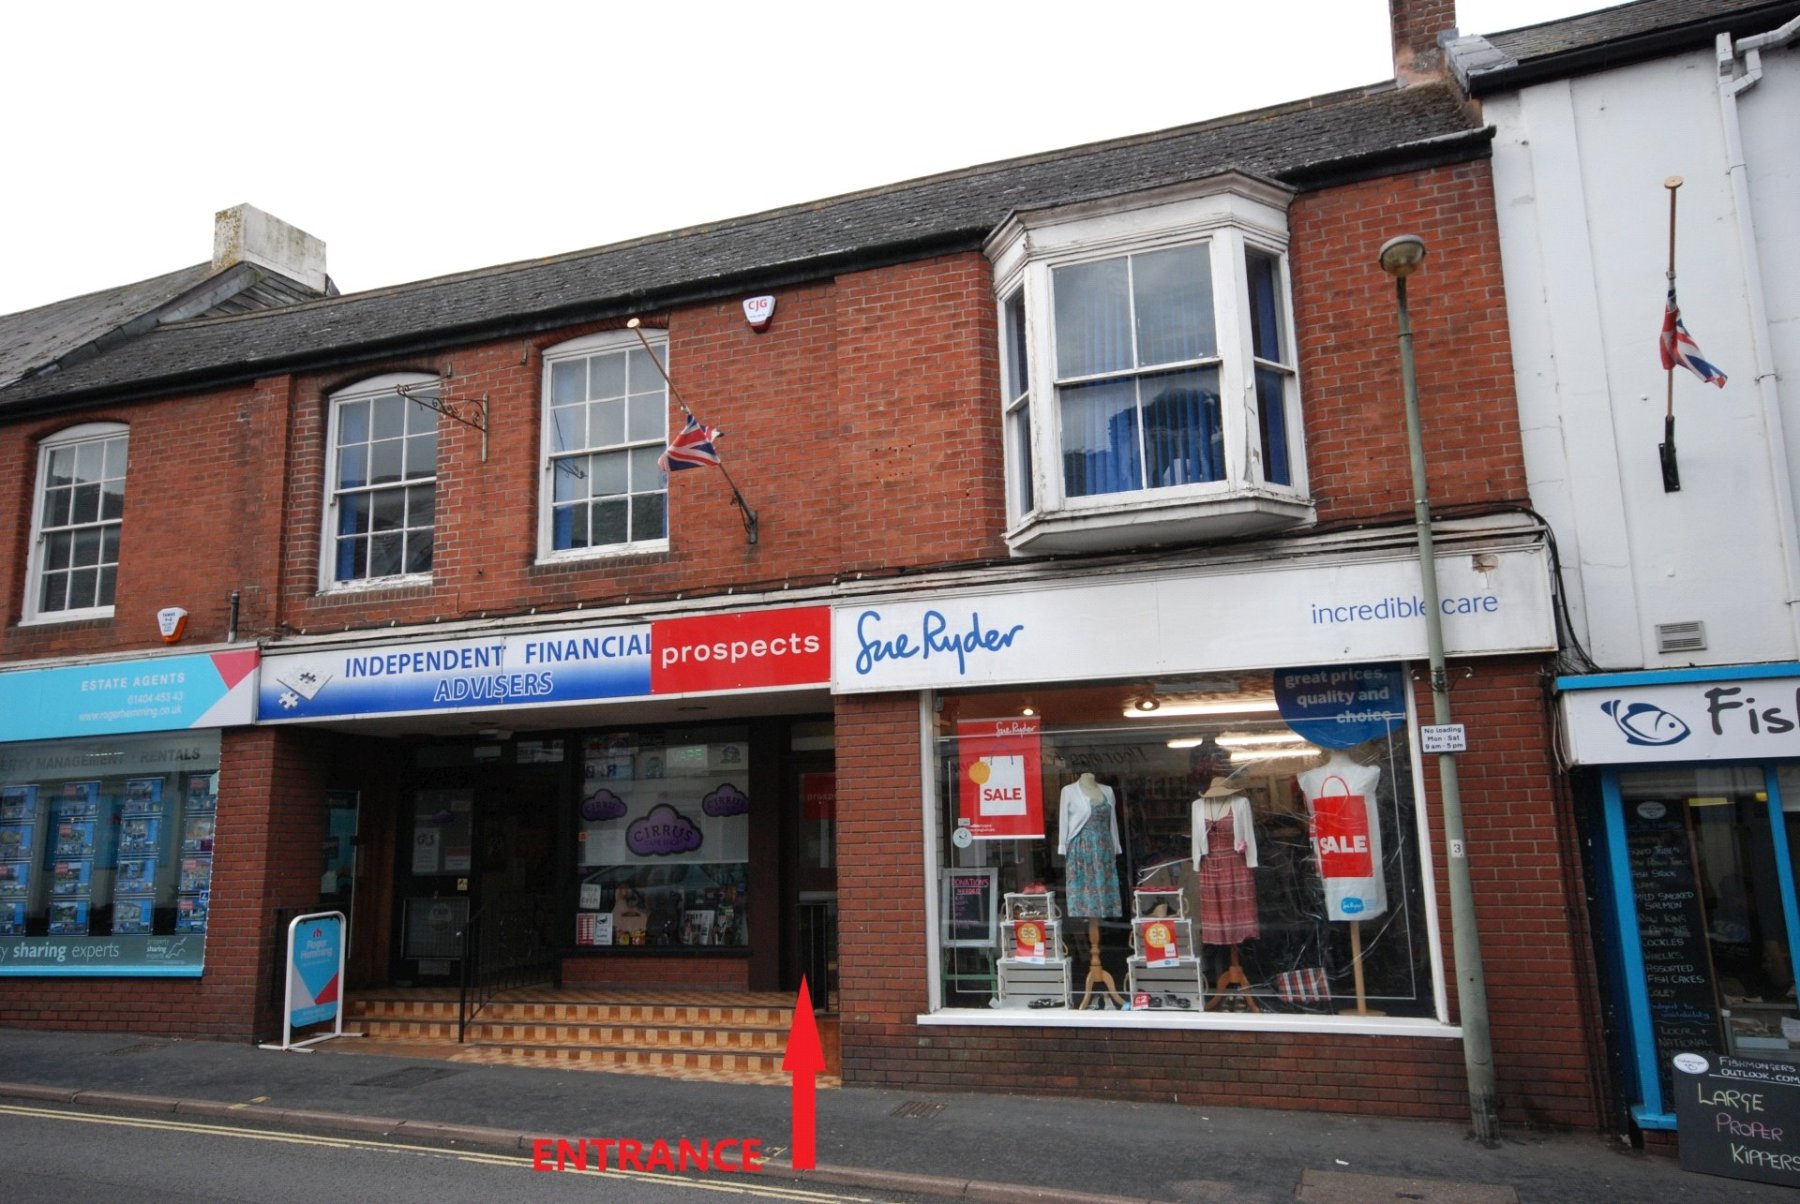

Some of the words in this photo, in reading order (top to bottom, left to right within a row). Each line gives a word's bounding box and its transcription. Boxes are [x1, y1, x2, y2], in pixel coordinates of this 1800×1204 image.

[748, 299, 768, 311] CJG
[1312, 595, 1426, 624] incredible
[1441, 595, 1498, 615] care
[661, 632, 820, 669] prospects
[856, 610, 920, 675] Sue
[923, 610, 1024, 675] Ryder
[345, 645, 507, 678] INDEPENDENT
[81, 677, 128, 691] ESTATE
[133, 672, 185, 687] AGENTS
[433, 671, 553, 702] ADVISERS
[1284, 673, 1328, 688] great
[1296, 691, 1354, 709] quality
[1358, 687, 1389, 700] and
[1336, 709, 1393, 724] choice
[141, 749, 200, 764] RENTALS
[984, 787, 1022, 801] SALE
[634, 824, 693, 842] CIRRUS
[1320, 835, 1368, 855] SALE
[1454, 844, 1461, 853] 3
[1658, 891, 1694, 901] SMOKED
[1645, 900, 1682, 910] SALMON
[13, 941, 66, 962] sharing
[72, 943, 119, 962] experts
[1647, 964, 1694, 973] ASSORTED
[1648, 974, 1669, 984] FISH
[1671, 974, 1705, 984] CAKES
[1661, 1026, 1696, 1035] LOCAL
[1719, 1056, 1796, 1073] FISHMONGERS
[1698, 1083, 1765, 1113] LARGE
[1716, 1112, 1783, 1142] PROPER
